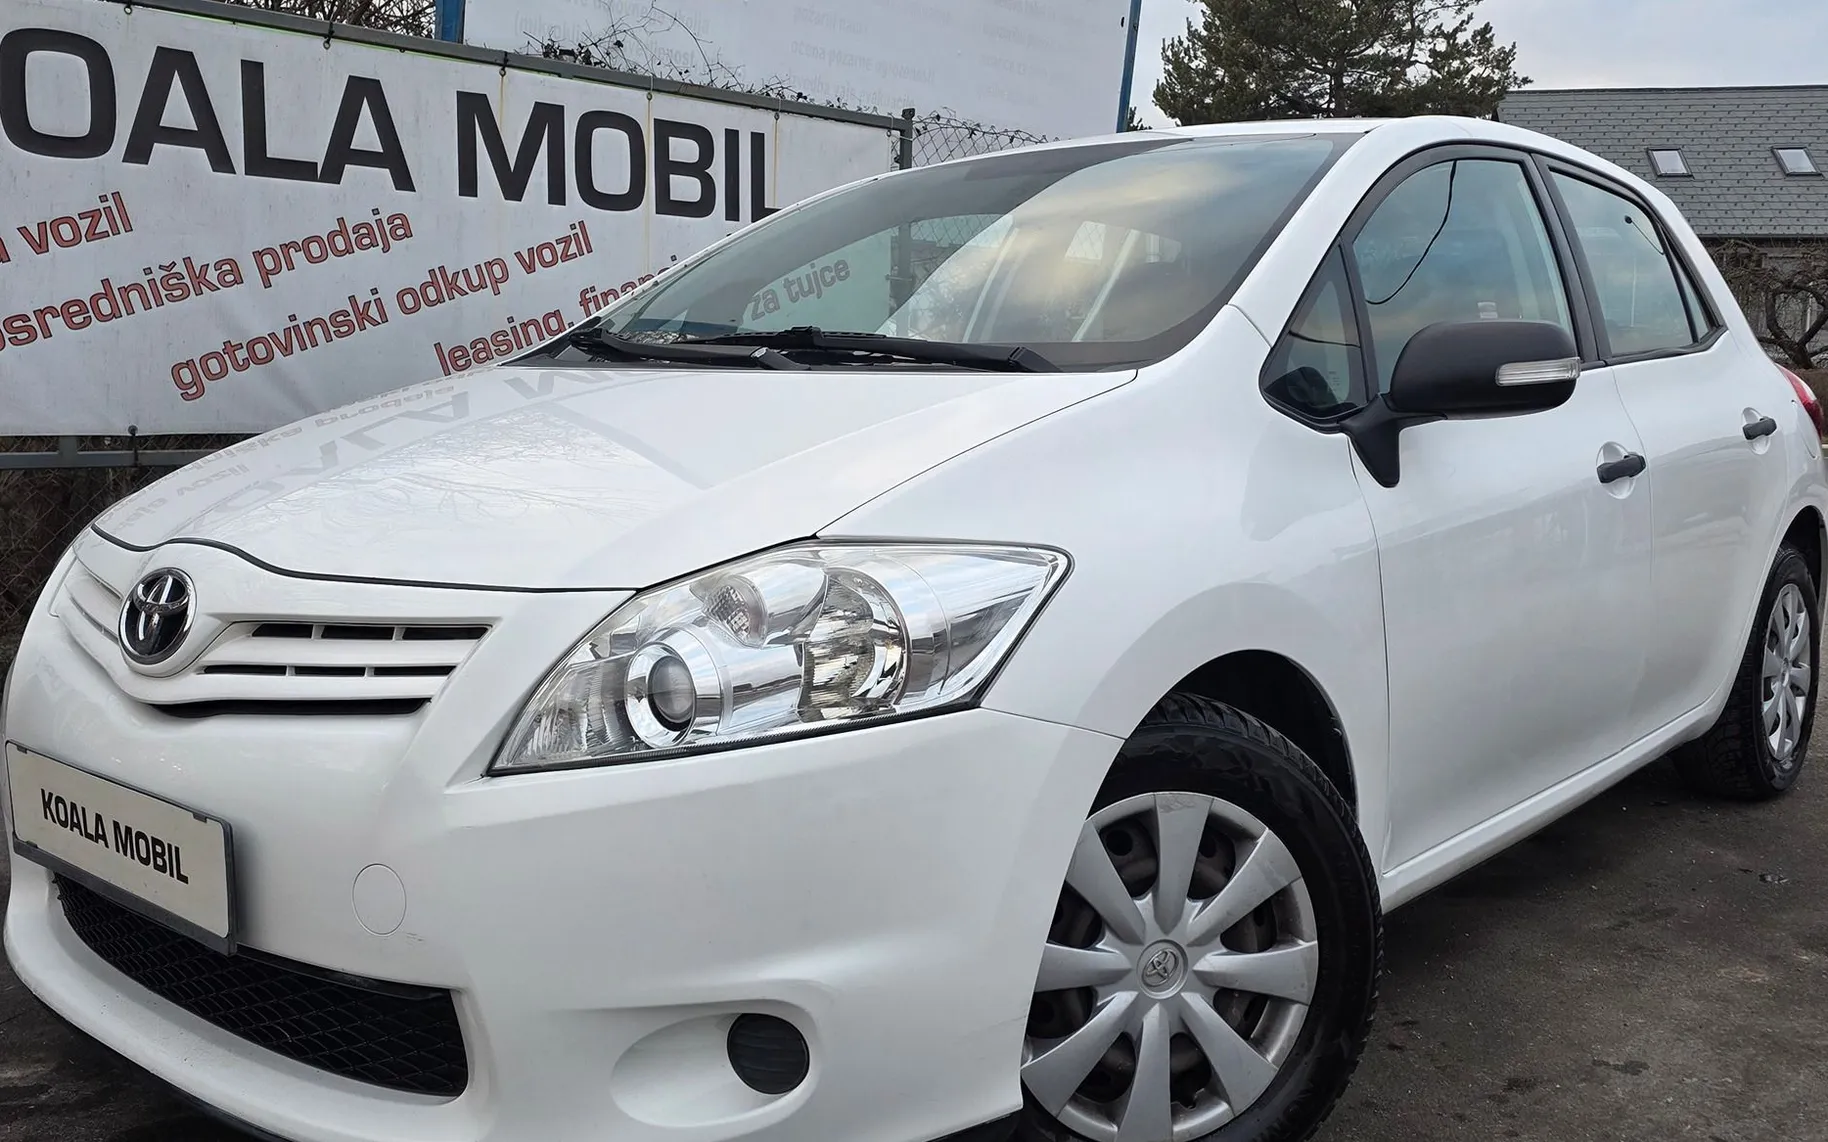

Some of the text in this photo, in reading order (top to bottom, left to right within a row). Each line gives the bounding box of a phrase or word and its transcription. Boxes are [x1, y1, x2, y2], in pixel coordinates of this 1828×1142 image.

[456, 90, 783, 224] MOBIL
[0, 208, 413, 351] sredniška prodaja
[17, 191, 133, 256] vozil
[170, 220, 594, 401] gotovinski odkup vozil
[750, 257, 851, 321] za tujce
[41, 788, 189, 885] KOALA MOBIL
